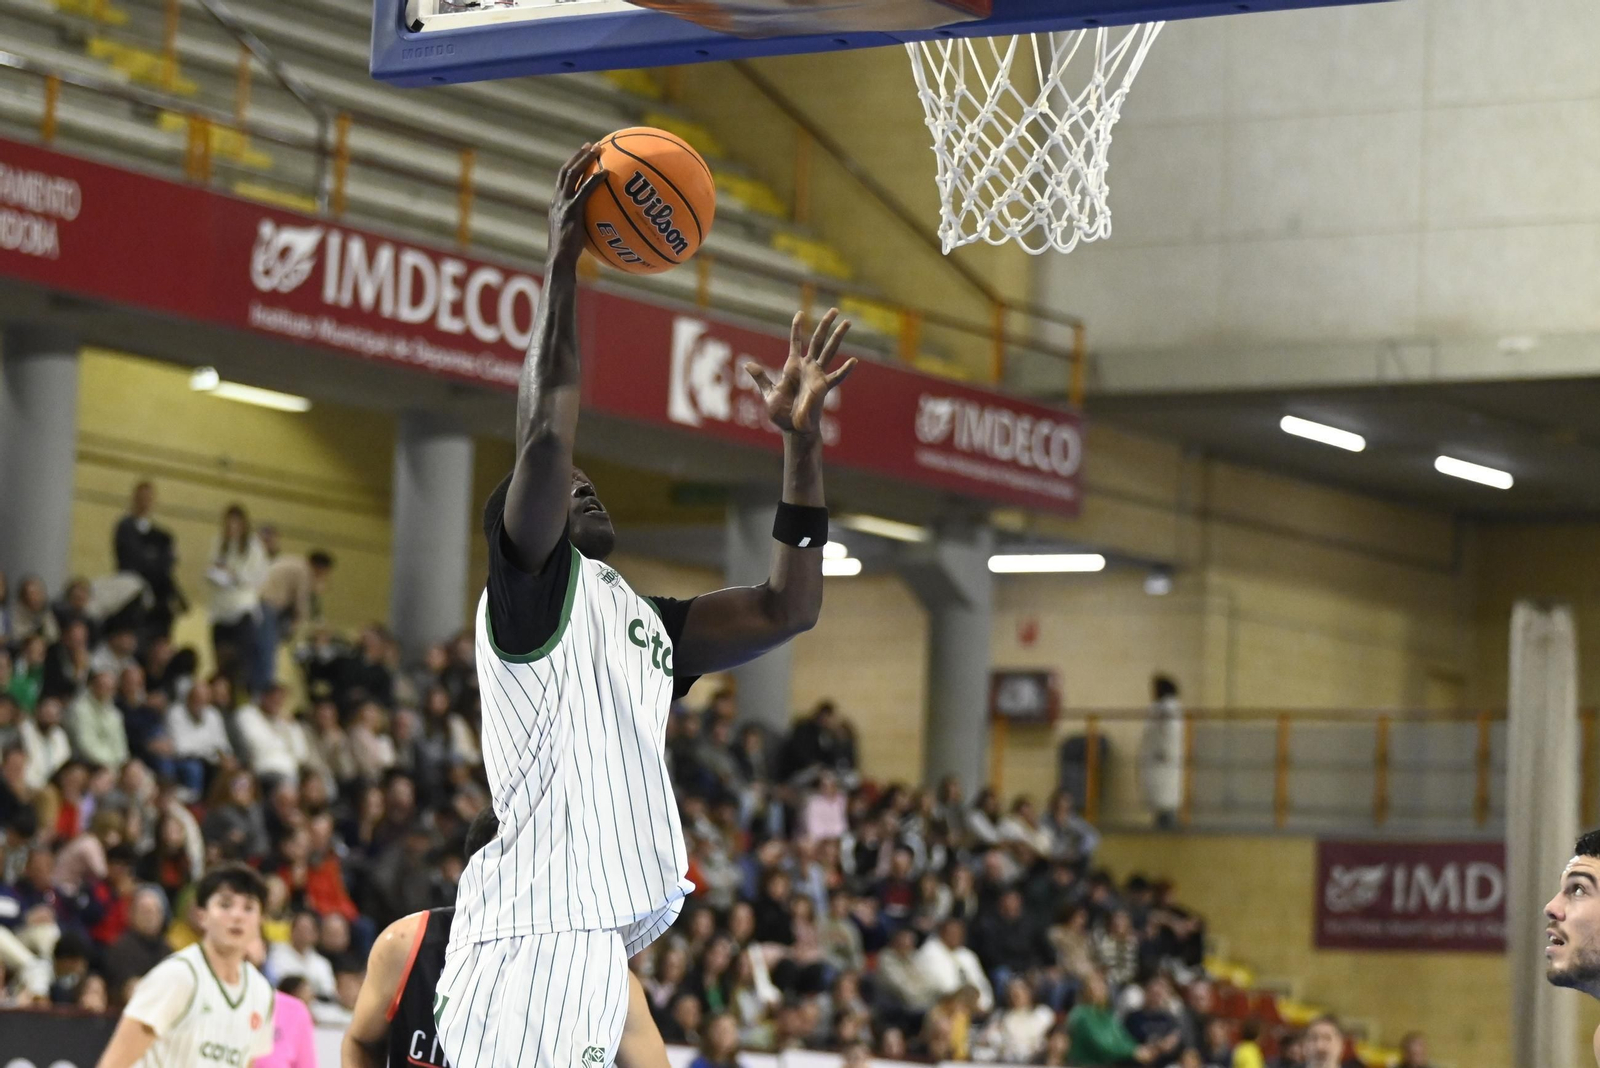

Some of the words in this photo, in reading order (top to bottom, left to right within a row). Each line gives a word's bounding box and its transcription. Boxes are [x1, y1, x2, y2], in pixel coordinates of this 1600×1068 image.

[402, 44, 455, 59] MONDO
[624, 170, 689, 256] Wilson
[322, 228, 543, 350] IMDECO
[953, 401, 1082, 477] IMDECO
[1392, 862, 1503, 914] IMD
